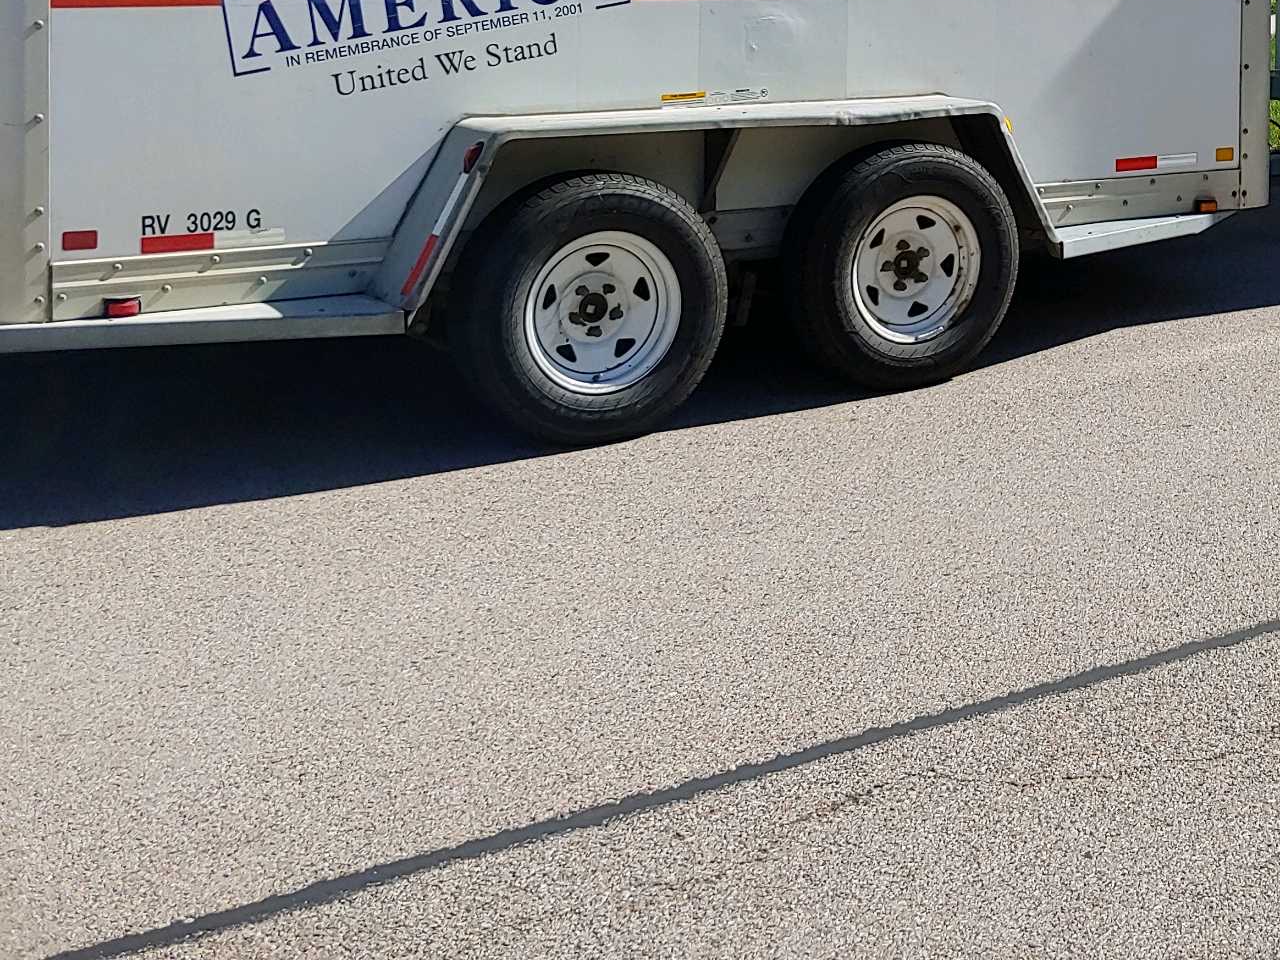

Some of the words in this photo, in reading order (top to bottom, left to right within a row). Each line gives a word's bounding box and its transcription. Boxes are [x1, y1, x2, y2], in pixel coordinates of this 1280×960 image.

[285, 54, 301, 67] IN
[304, 31, 420, 64] REMEMBRANCE
[424, 27, 442, 42] OF
[446, 12, 529, 38] SEPTEMBER
[532, 8, 552, 24] 11,
[554, 3, 584, 19] 2001
[332, 58, 429, 96] United
[435, 49, 476, 76] We
[486, 32, 558, 67] Stand
[140, 214, 171, 237] RV
[186, 210, 237, 233] 3029
[247, 209, 261, 229] G
